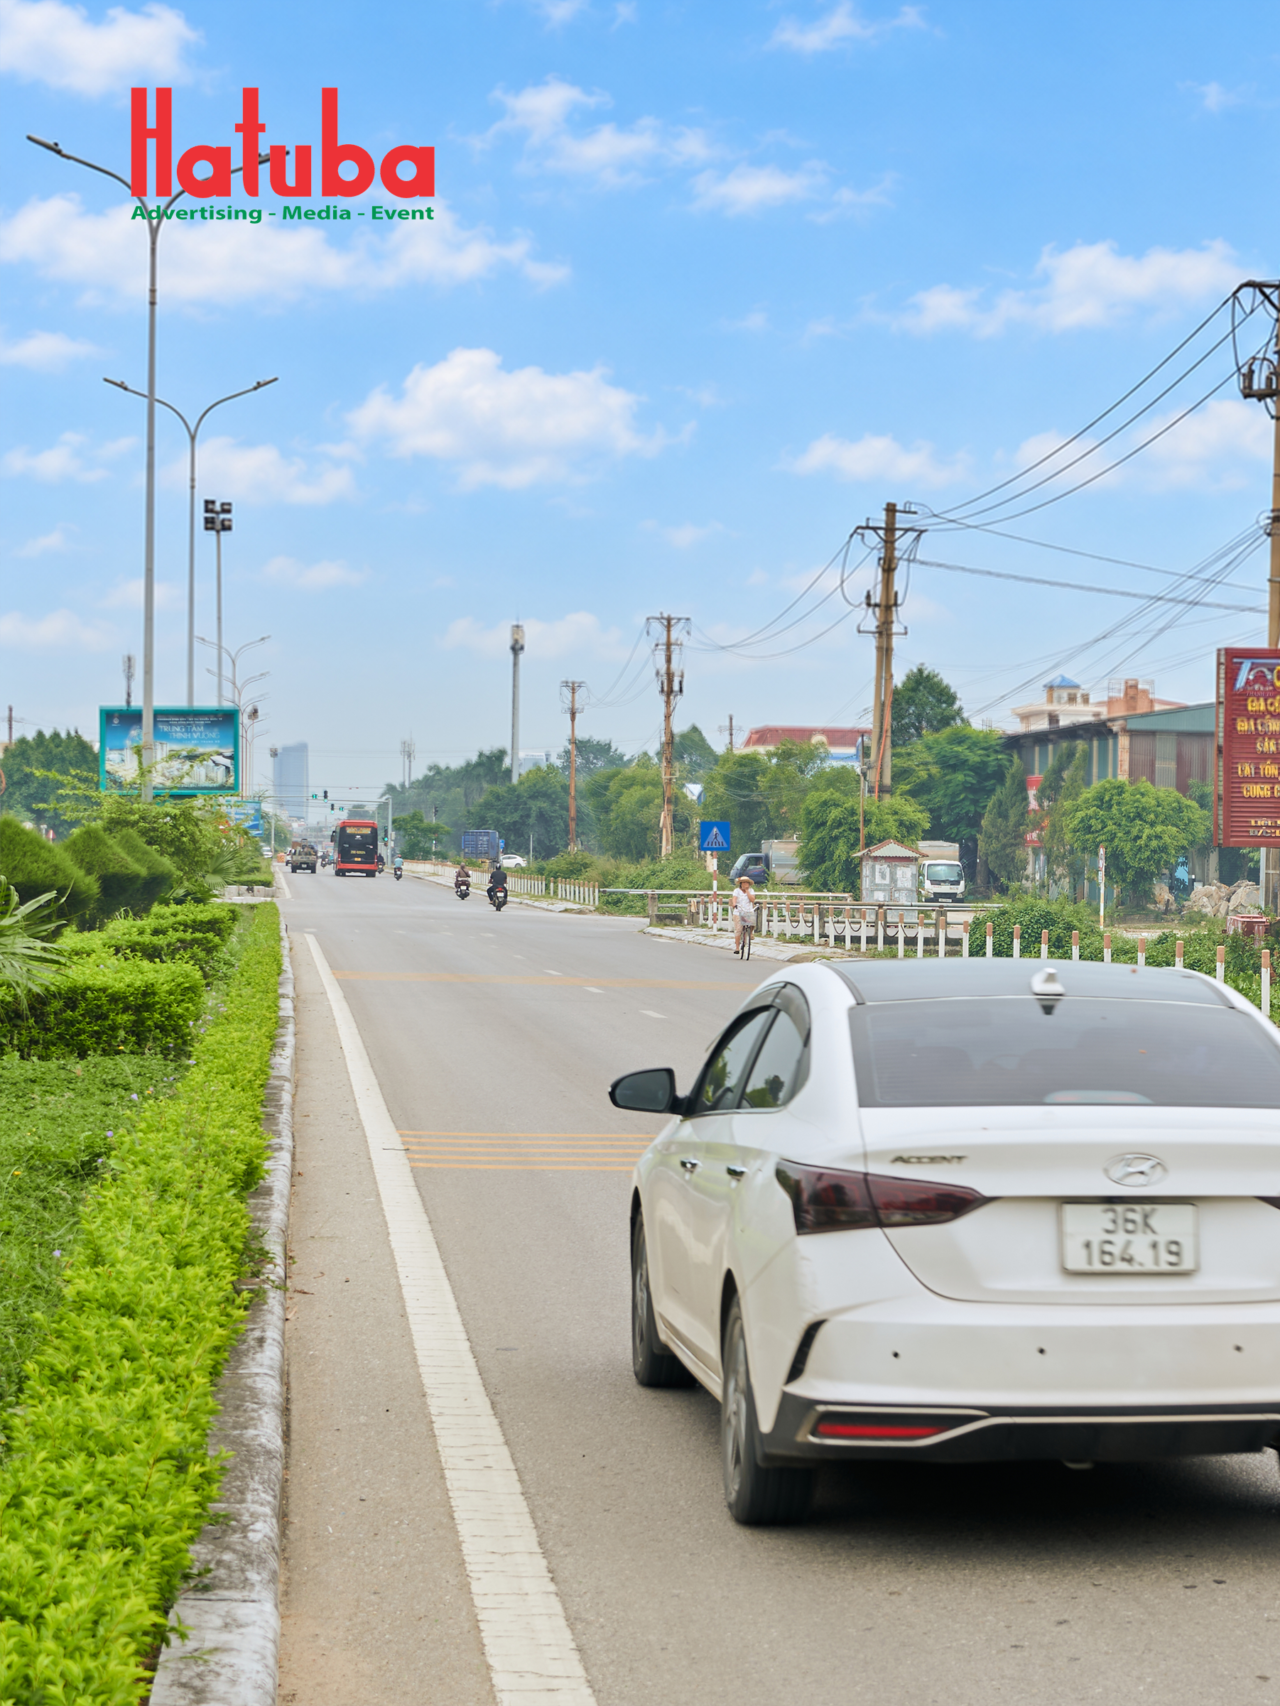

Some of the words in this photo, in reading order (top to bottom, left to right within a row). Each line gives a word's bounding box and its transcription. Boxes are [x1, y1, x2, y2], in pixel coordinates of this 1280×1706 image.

[1243, 784, 1271, 798] CUNG
[891, 1155, 967, 1164] ACCENT
[1101, 1207, 1159, 1235] 36K
[1082, 1239, 1183, 1267] 164.19
